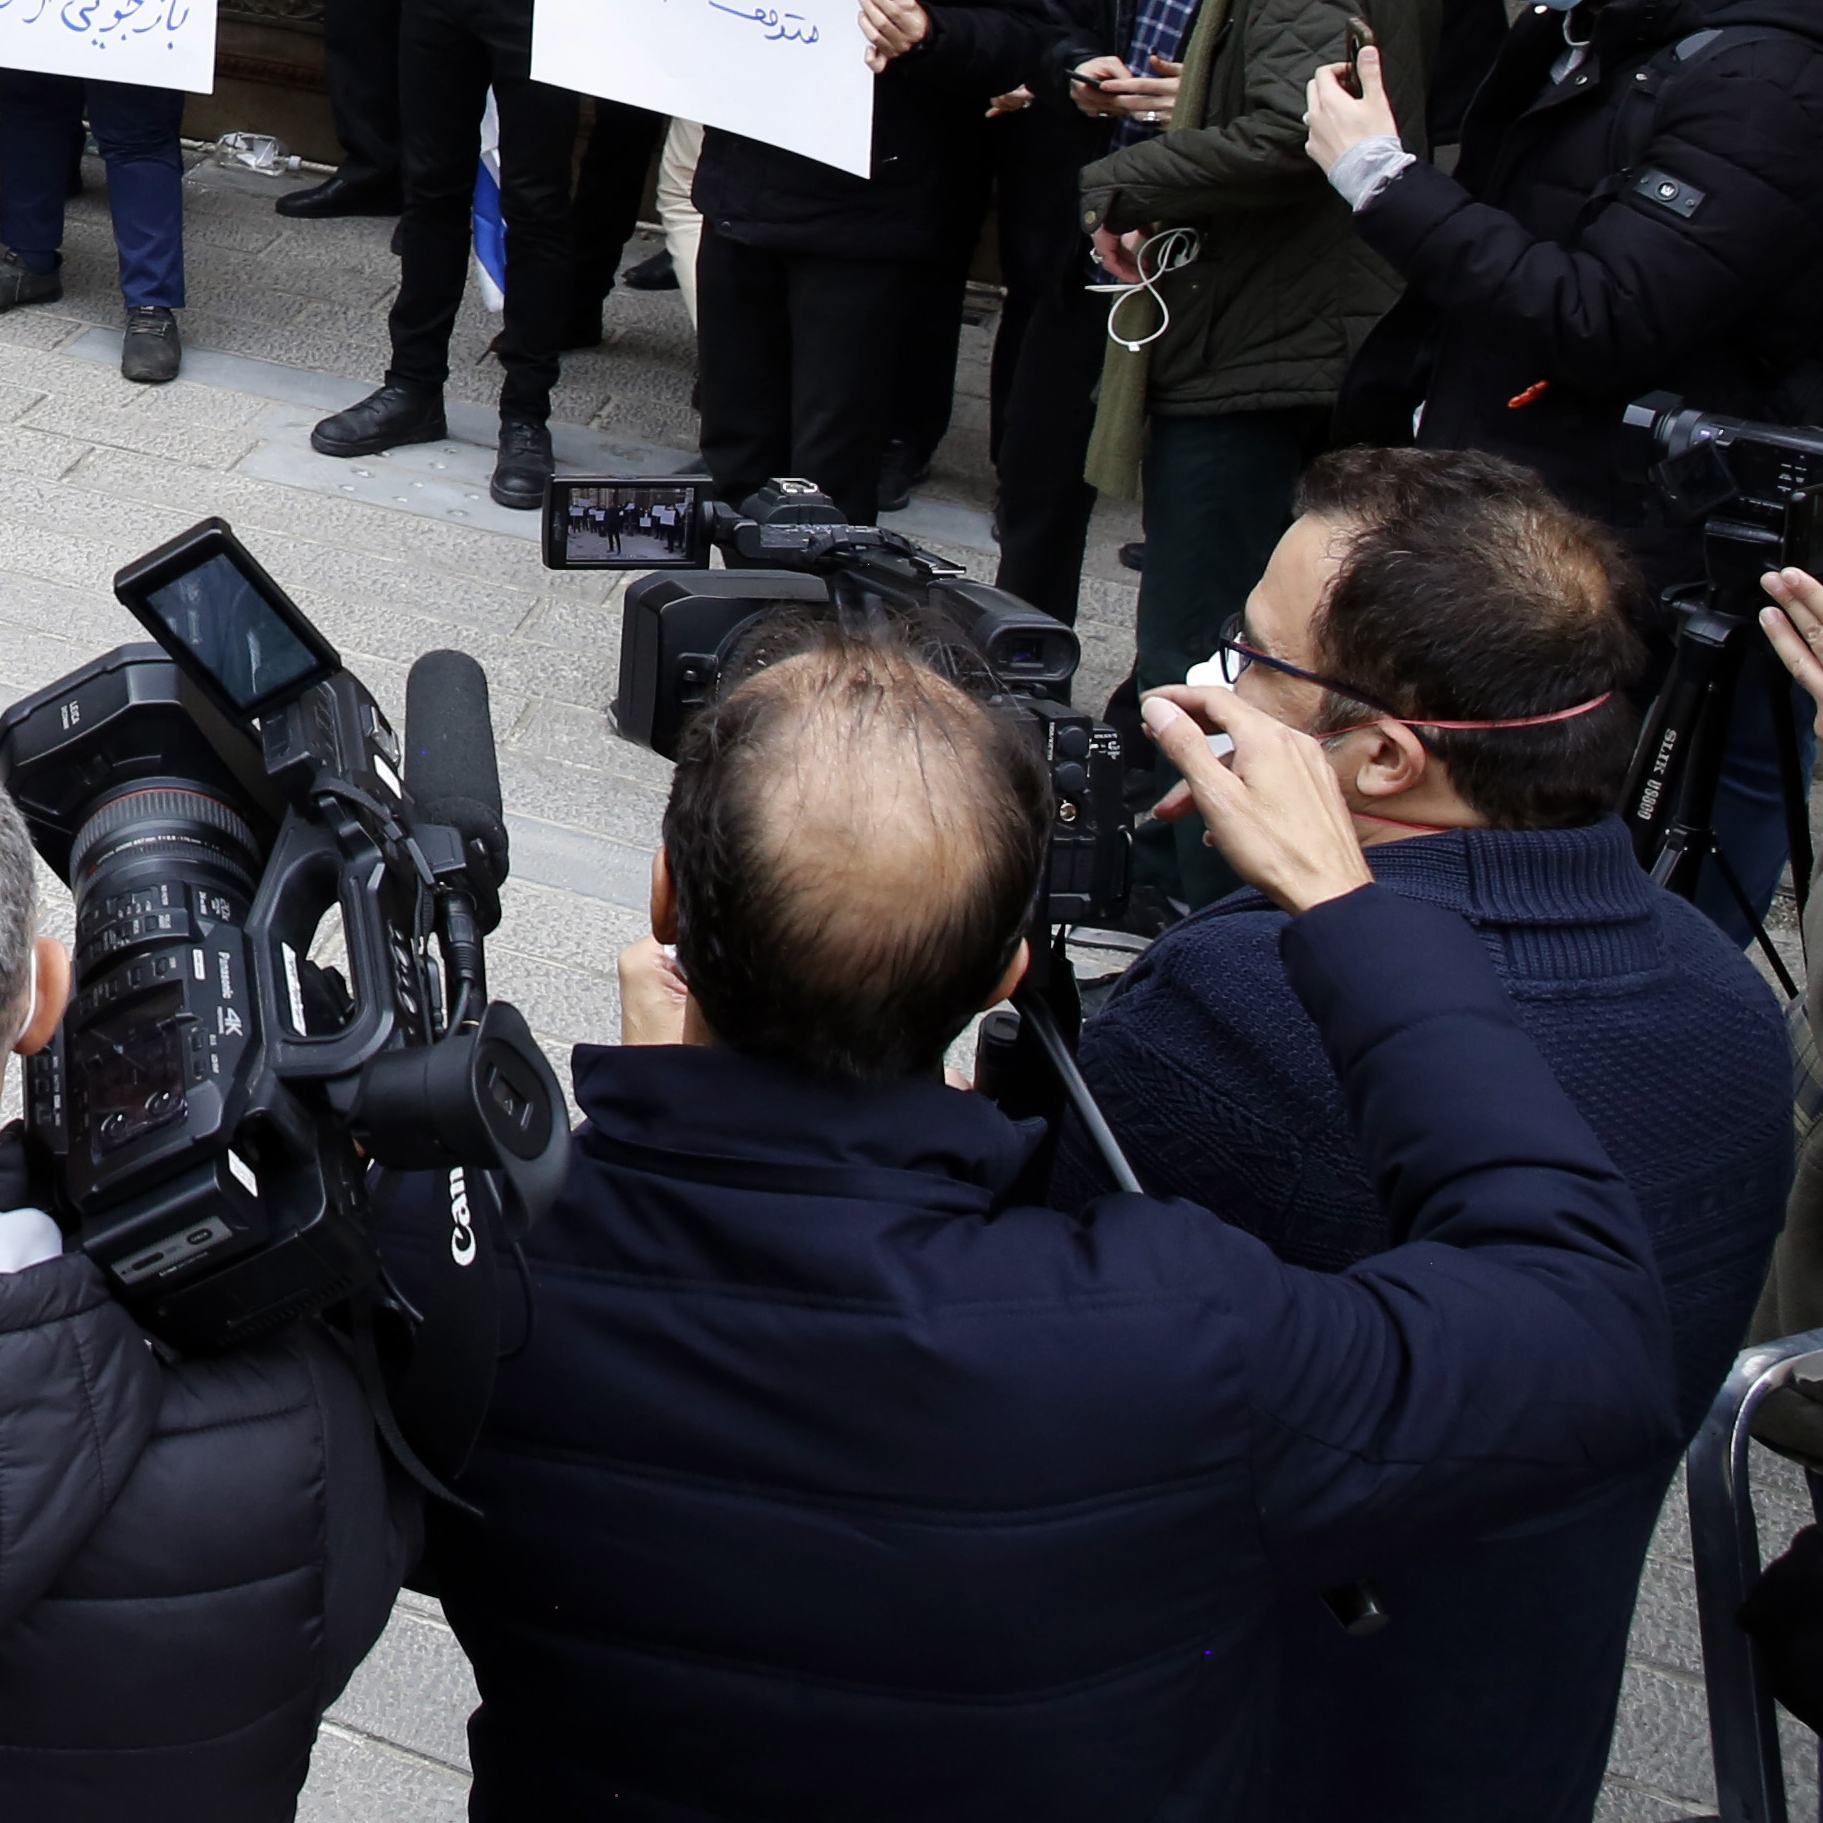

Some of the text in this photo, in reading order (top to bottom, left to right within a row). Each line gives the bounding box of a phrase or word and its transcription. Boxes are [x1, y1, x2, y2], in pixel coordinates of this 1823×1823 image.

[1653, 728, 1677, 775] SLIK
[218, 951, 234, 1000] Panasonic
[224, 1007, 243, 1037] 4K
[449, 1166, 476, 1266] Can
